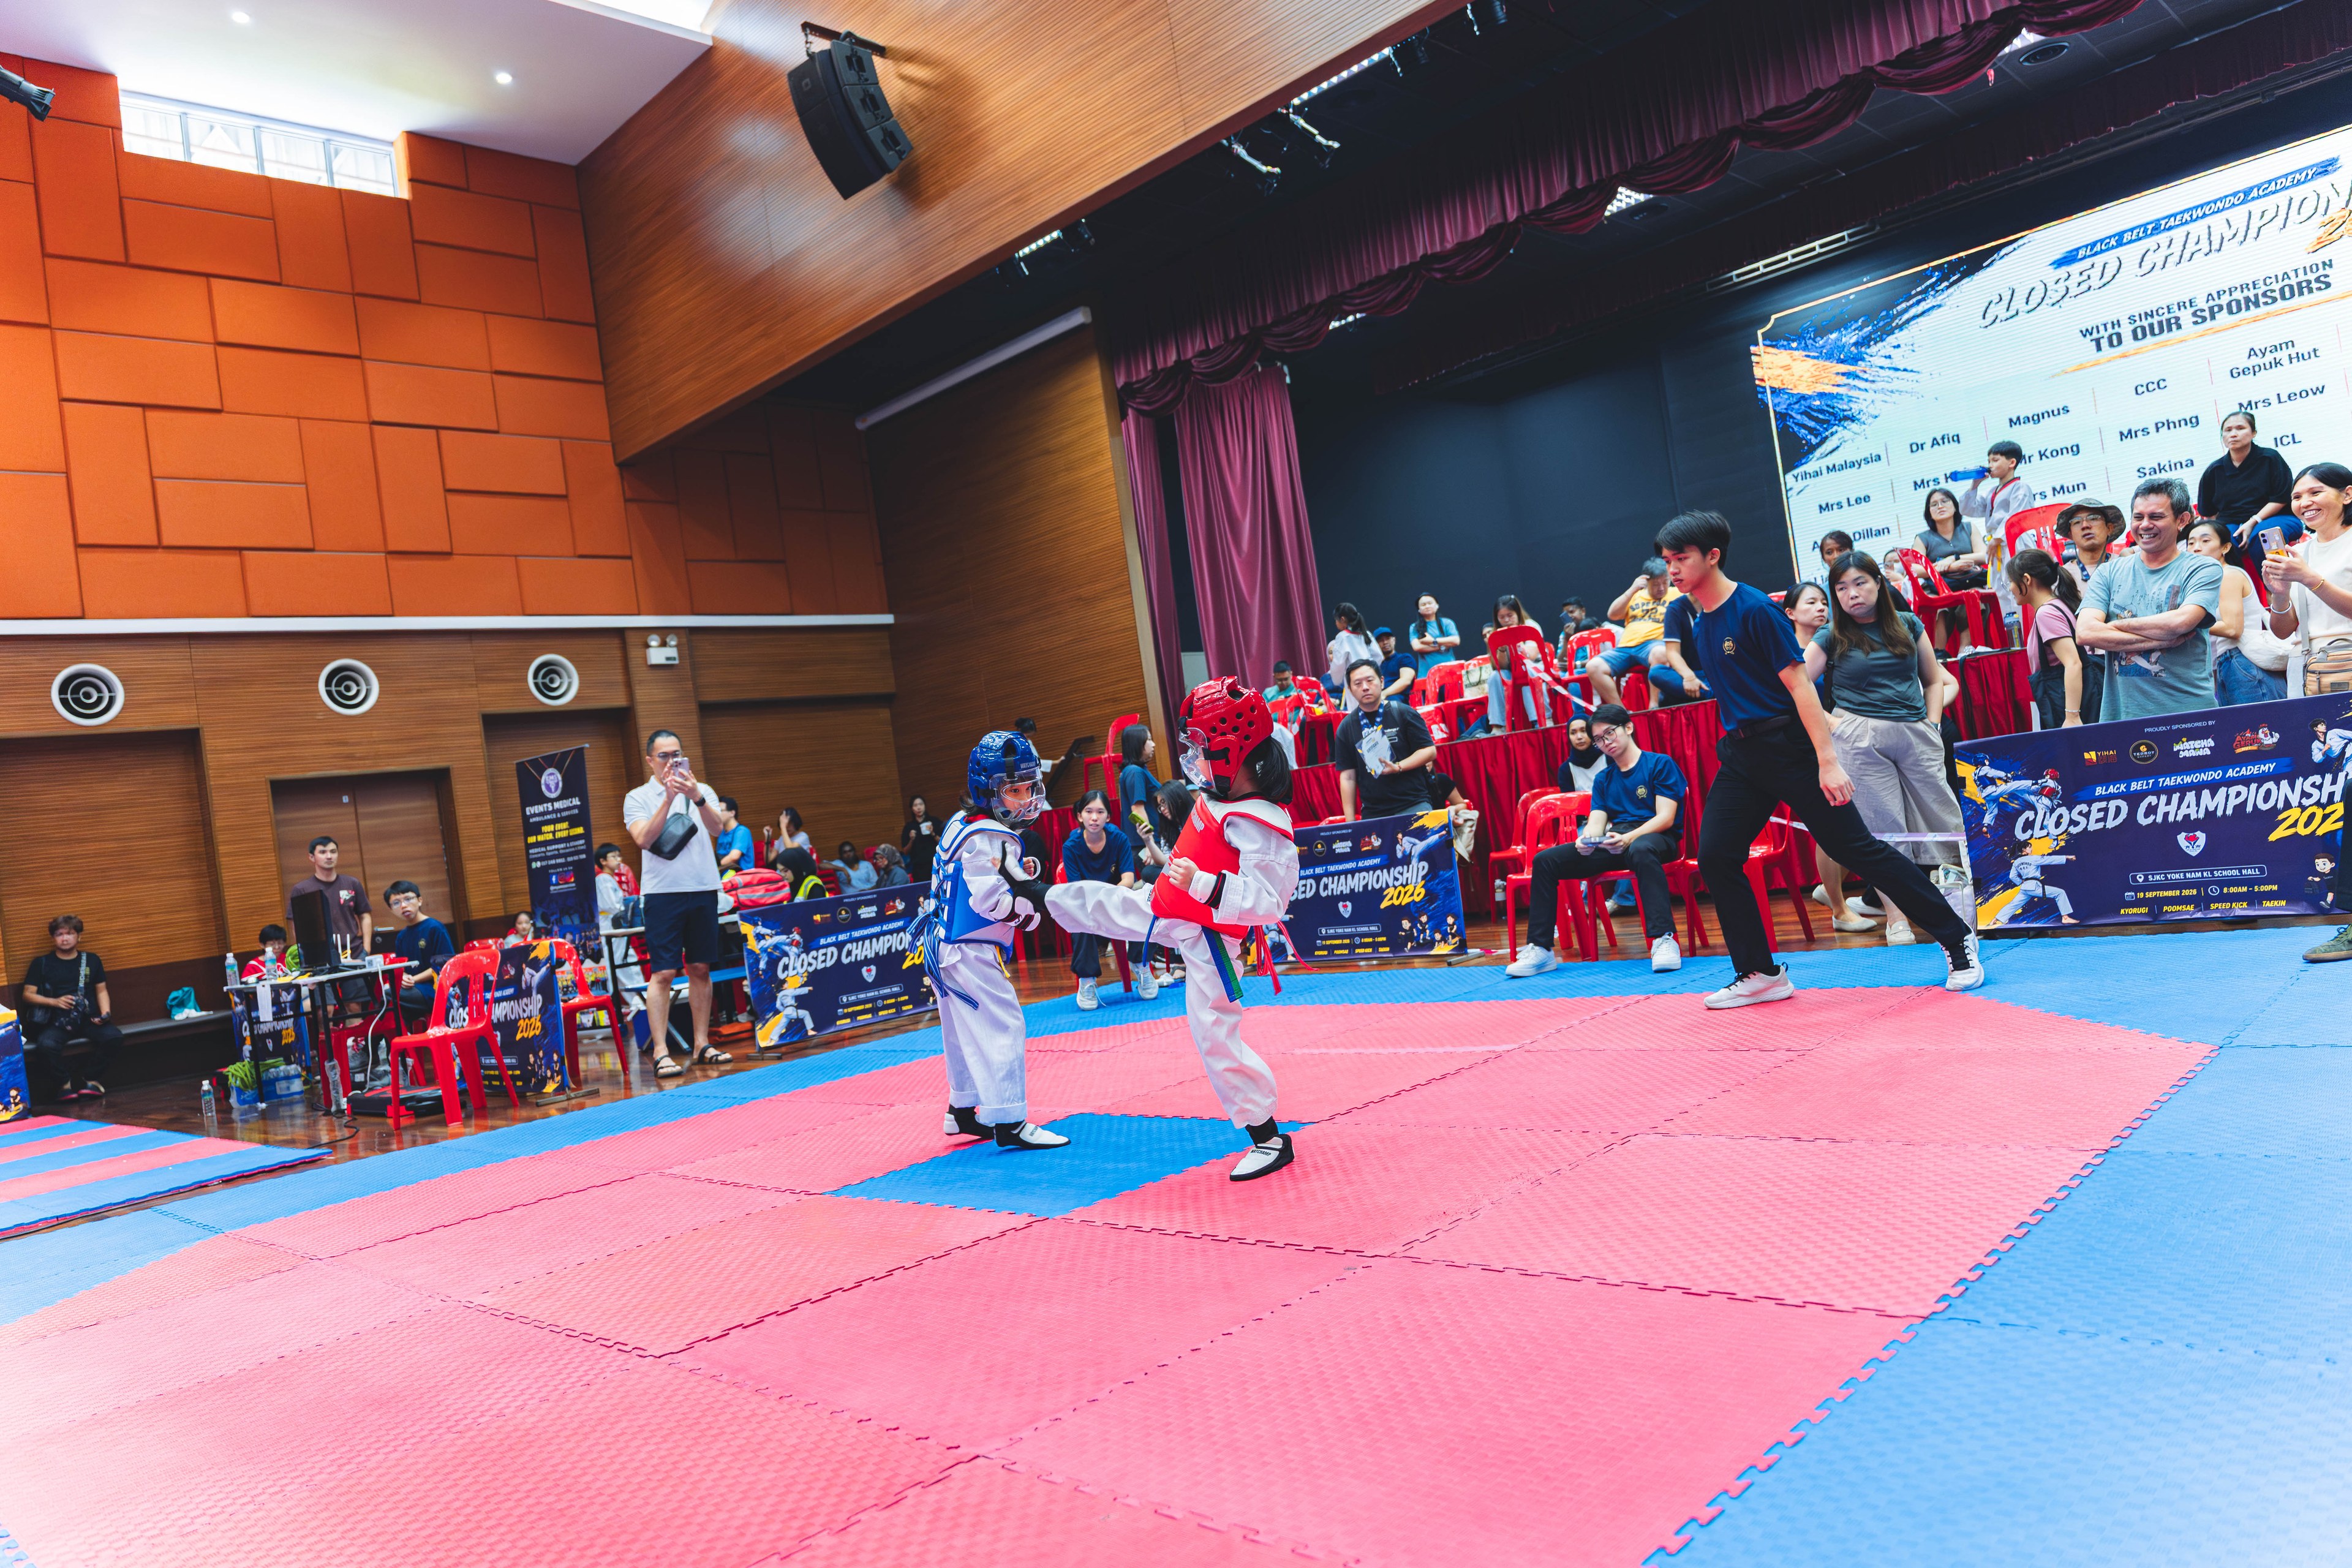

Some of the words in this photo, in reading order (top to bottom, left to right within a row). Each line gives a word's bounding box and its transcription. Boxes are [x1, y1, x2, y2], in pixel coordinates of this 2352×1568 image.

[2077, 236, 2117, 259] BLACK
[2122, 222, 2155, 244] BELT
[2159, 193, 2245, 231] TAEKWONDO
[2247, 167, 2318, 200] ACADEMY
[1978, 255, 2122, 329] CLOSED
[2079, 319, 2122, 339] WITH
[2127, 296, 2198, 326] SINCERE
[2205, 258, 2334, 304] APPRECIATION
[2089, 331, 2123, 353] TO
[2131, 315, 2182, 343] OUR
[2192, 273, 2333, 326] SPONSORS
[2247, 339, 2296, 360] Ayam
[2229, 353, 2284, 379] Gepuk
[2288, 347, 2321, 365] Hut
[2134, 378, 2168, 396] CCC
[2237, 398, 2272, 412] Mrs
[2277, 385, 2326, 404] Leow
[2008, 405, 2070, 428] Magnus
[2119, 425, 2150, 442] Mrs
[2154, 415, 2200, 434] Phng
[1909, 441, 1926, 453] Dr
[1930, 432, 1961, 448] Afiq
[2038, 443, 2081, 461] Kong
[2273, 432, 2302, 448] ICL
[1792, 466, 1823, 483] Yihai
[1826, 452, 1882, 475] Malaysia
[2136, 458, 2195, 478] Sakina
[1912, 475, 1940, 491] Mrs
[2032, 490, 2048, 501] rs
[2051, 481, 2087, 497] Mun
[1818, 500, 1844, 514] Mrs
[1847, 494, 1871, 507] Lee
[1852, 525, 1890, 541] Dillan
[2171, 721, 2207, 730] SPONSORED
[2173, 737, 2215, 752] MATCHA
[2179, 748, 2211, 758] MANA
[2095, 783, 2127, 796] BLACK
[2130, 779, 2155, 791] BELT
[2158, 770, 2223, 787] TAEKWONDO
[2225, 763, 2277, 778] ACADEMY
[526, 802, 553, 815] EVENTS
[553, 797, 581, 810] MEDICAL
[529, 812, 557, 823] AMBULANCE
[2014, 799, 2129, 842] CLOSED
[2137, 771, 2346, 826] CHAMPIONSH
[2267, 801, 2344, 842] 202
[1327, 861, 1357, 872] TAEKWONDO
[1357, 858, 1381, 867] ACADEMY
[1289, 878, 1316, 902] SED
[1319, 861, 1429, 898] CHAMPIONSHIP
[1379, 880, 1426, 910] 2026
[2145, 889, 2180, 899] SEPTEMBER
[820, 935, 837, 945] BLACK
[838, 932, 850, 941] BELT
[851, 925, 881, 938] TAEKWONDO
[882, 920, 904, 931] ACADEMY
[777, 946, 839, 980] CLOSED
[902, 945, 924, 970] 20
[448, 1008, 469, 1029] CLOS
[491, 993, 543, 1024] AMPIONSHIP
[516, 1014, 542, 1041] 2026
